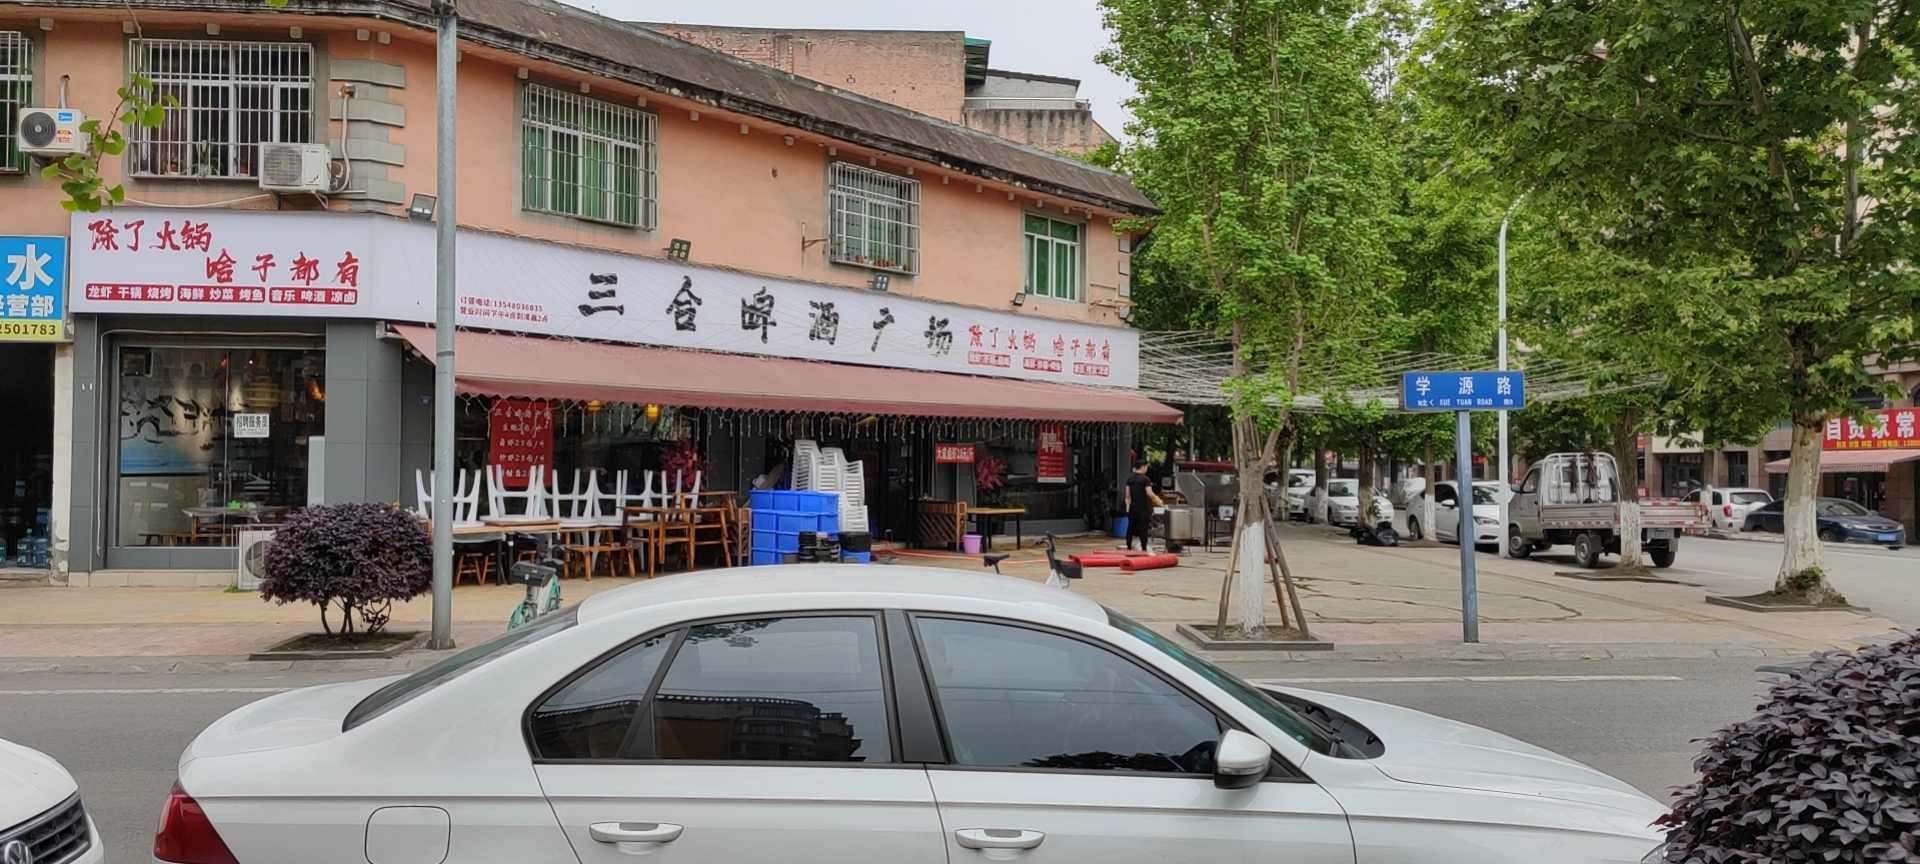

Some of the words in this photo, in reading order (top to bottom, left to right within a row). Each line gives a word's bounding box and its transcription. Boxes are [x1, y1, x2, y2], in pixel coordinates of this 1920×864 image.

[88, 219, 212, 252] 除了火锅
[6, 244, 54, 290] 水
[205, 248, 358, 287] 啥子都有
[88, 285, 112, 299] 龙虾
[118, 287, 142, 299] 干锅
[147, 287, 172, 300] 烧烤
[180, 287, 205, 300] 海鲜
[209, 288, 234, 300] 炒菜
[239, 288, 264, 301] 烤鱼
[271, 289, 295, 301] 音乐
[301, 290, 326, 302] 啤酒
[331, 290, 356, 303] 凉卤
[0, 294, 54, 317] 营部
[578, 272, 953, 357] 三合啤酒广场
[968, 324, 1037, 352] 除了火锅
[1416, 376, 1511, 396] 学源路
[1477, 398, 1493, 406] ROAD
[236, 415, 268, 428] 招聘服务员
